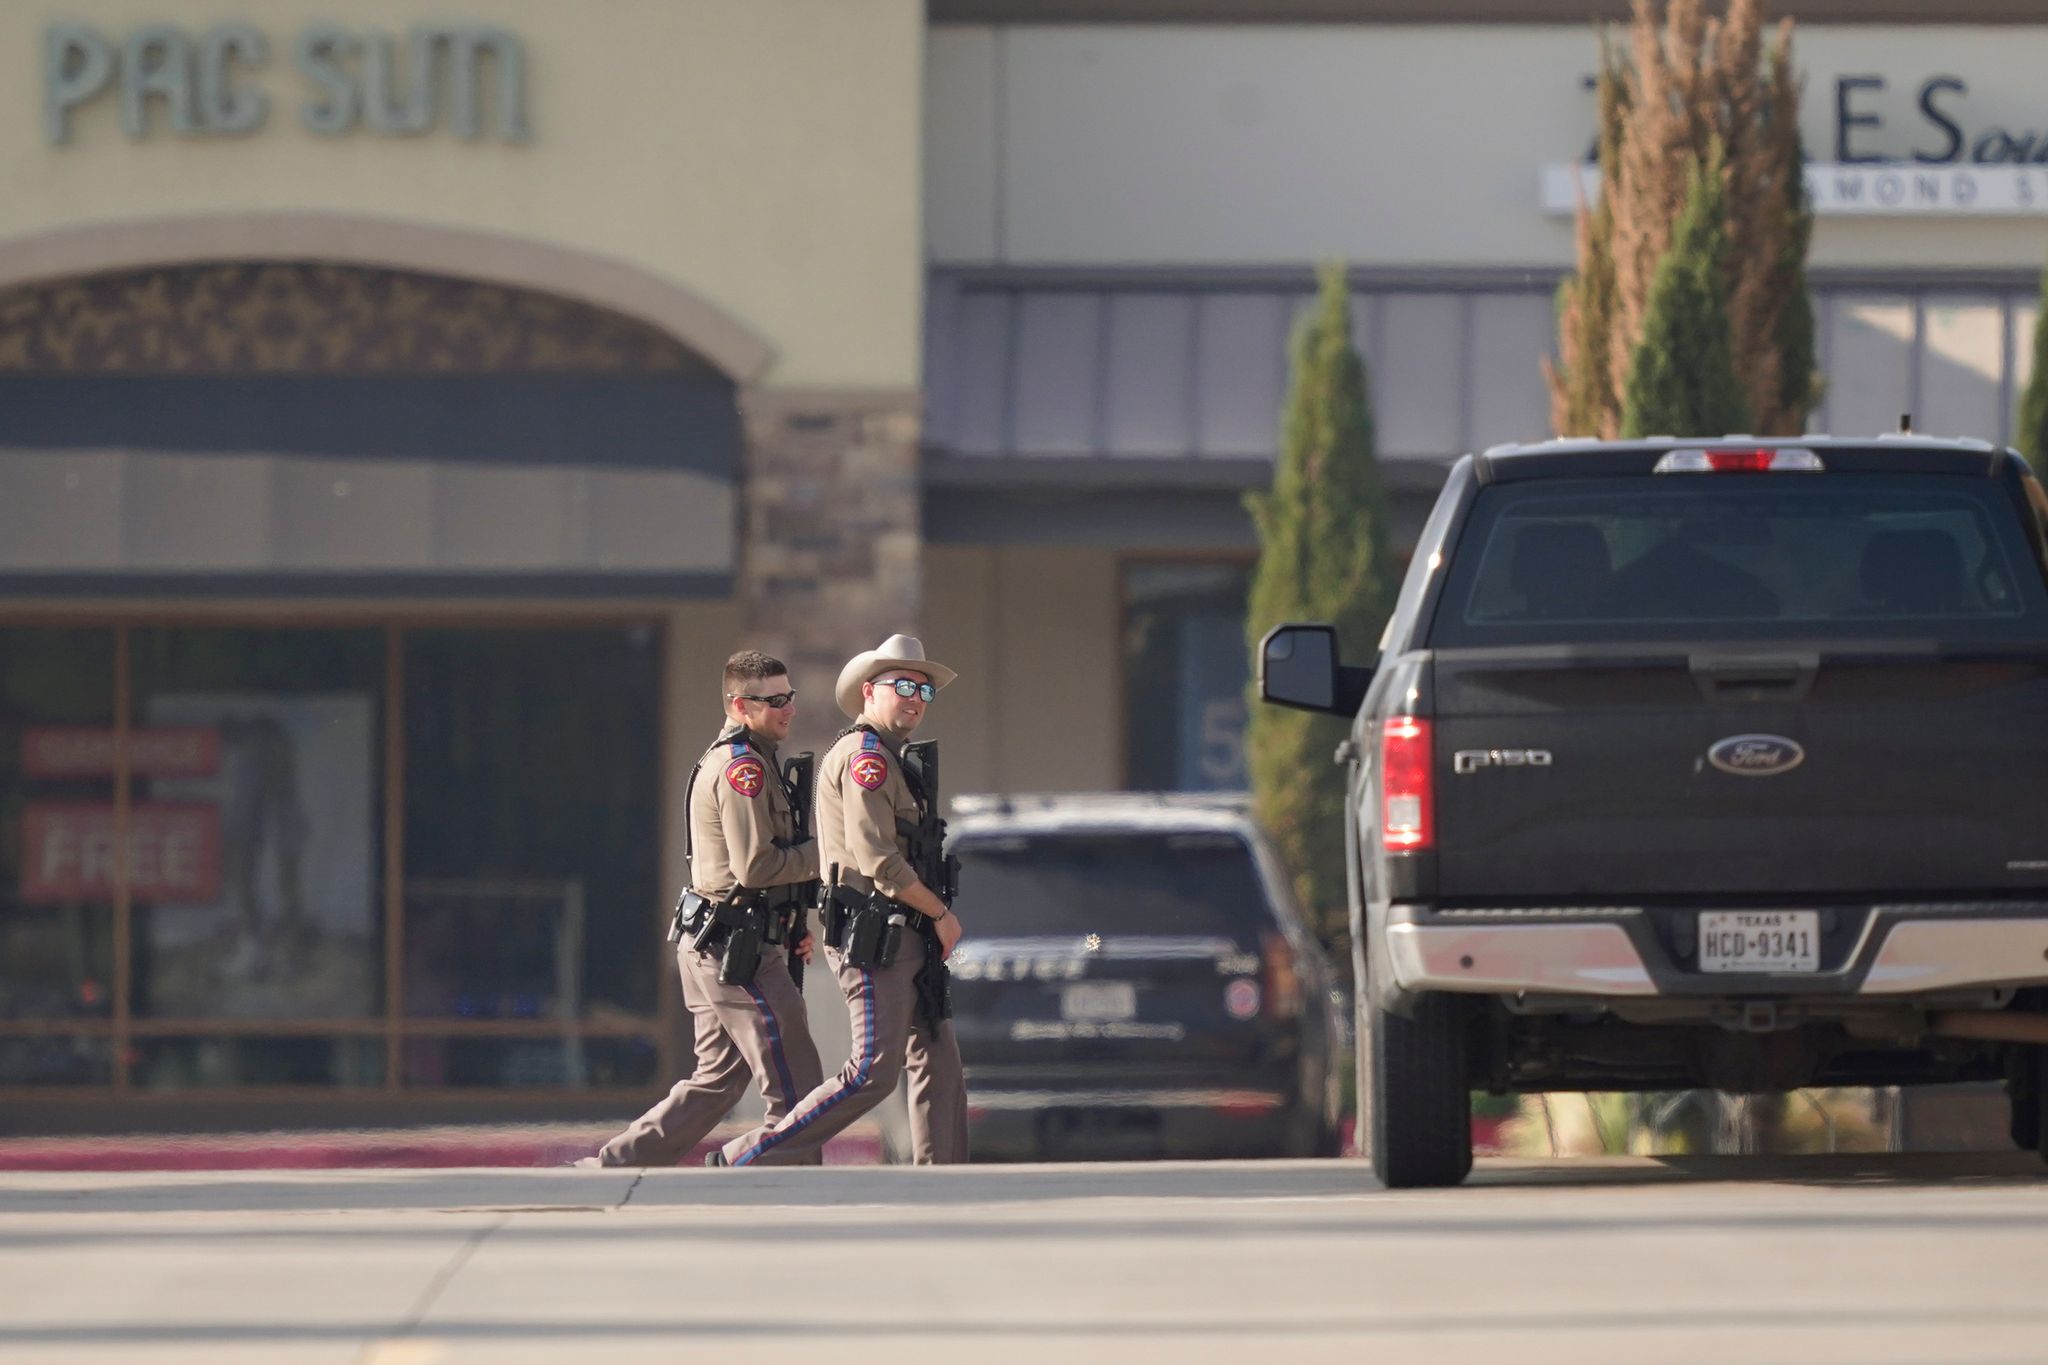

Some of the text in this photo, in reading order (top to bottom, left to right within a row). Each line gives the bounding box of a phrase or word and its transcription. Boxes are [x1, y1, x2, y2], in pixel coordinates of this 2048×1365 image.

[43, 24, 270, 145] PAC
[1731, 742, 1781, 767] Ford
[42, 828, 198, 887] FREE
[1736, 914, 1782, 927] TEXAS
